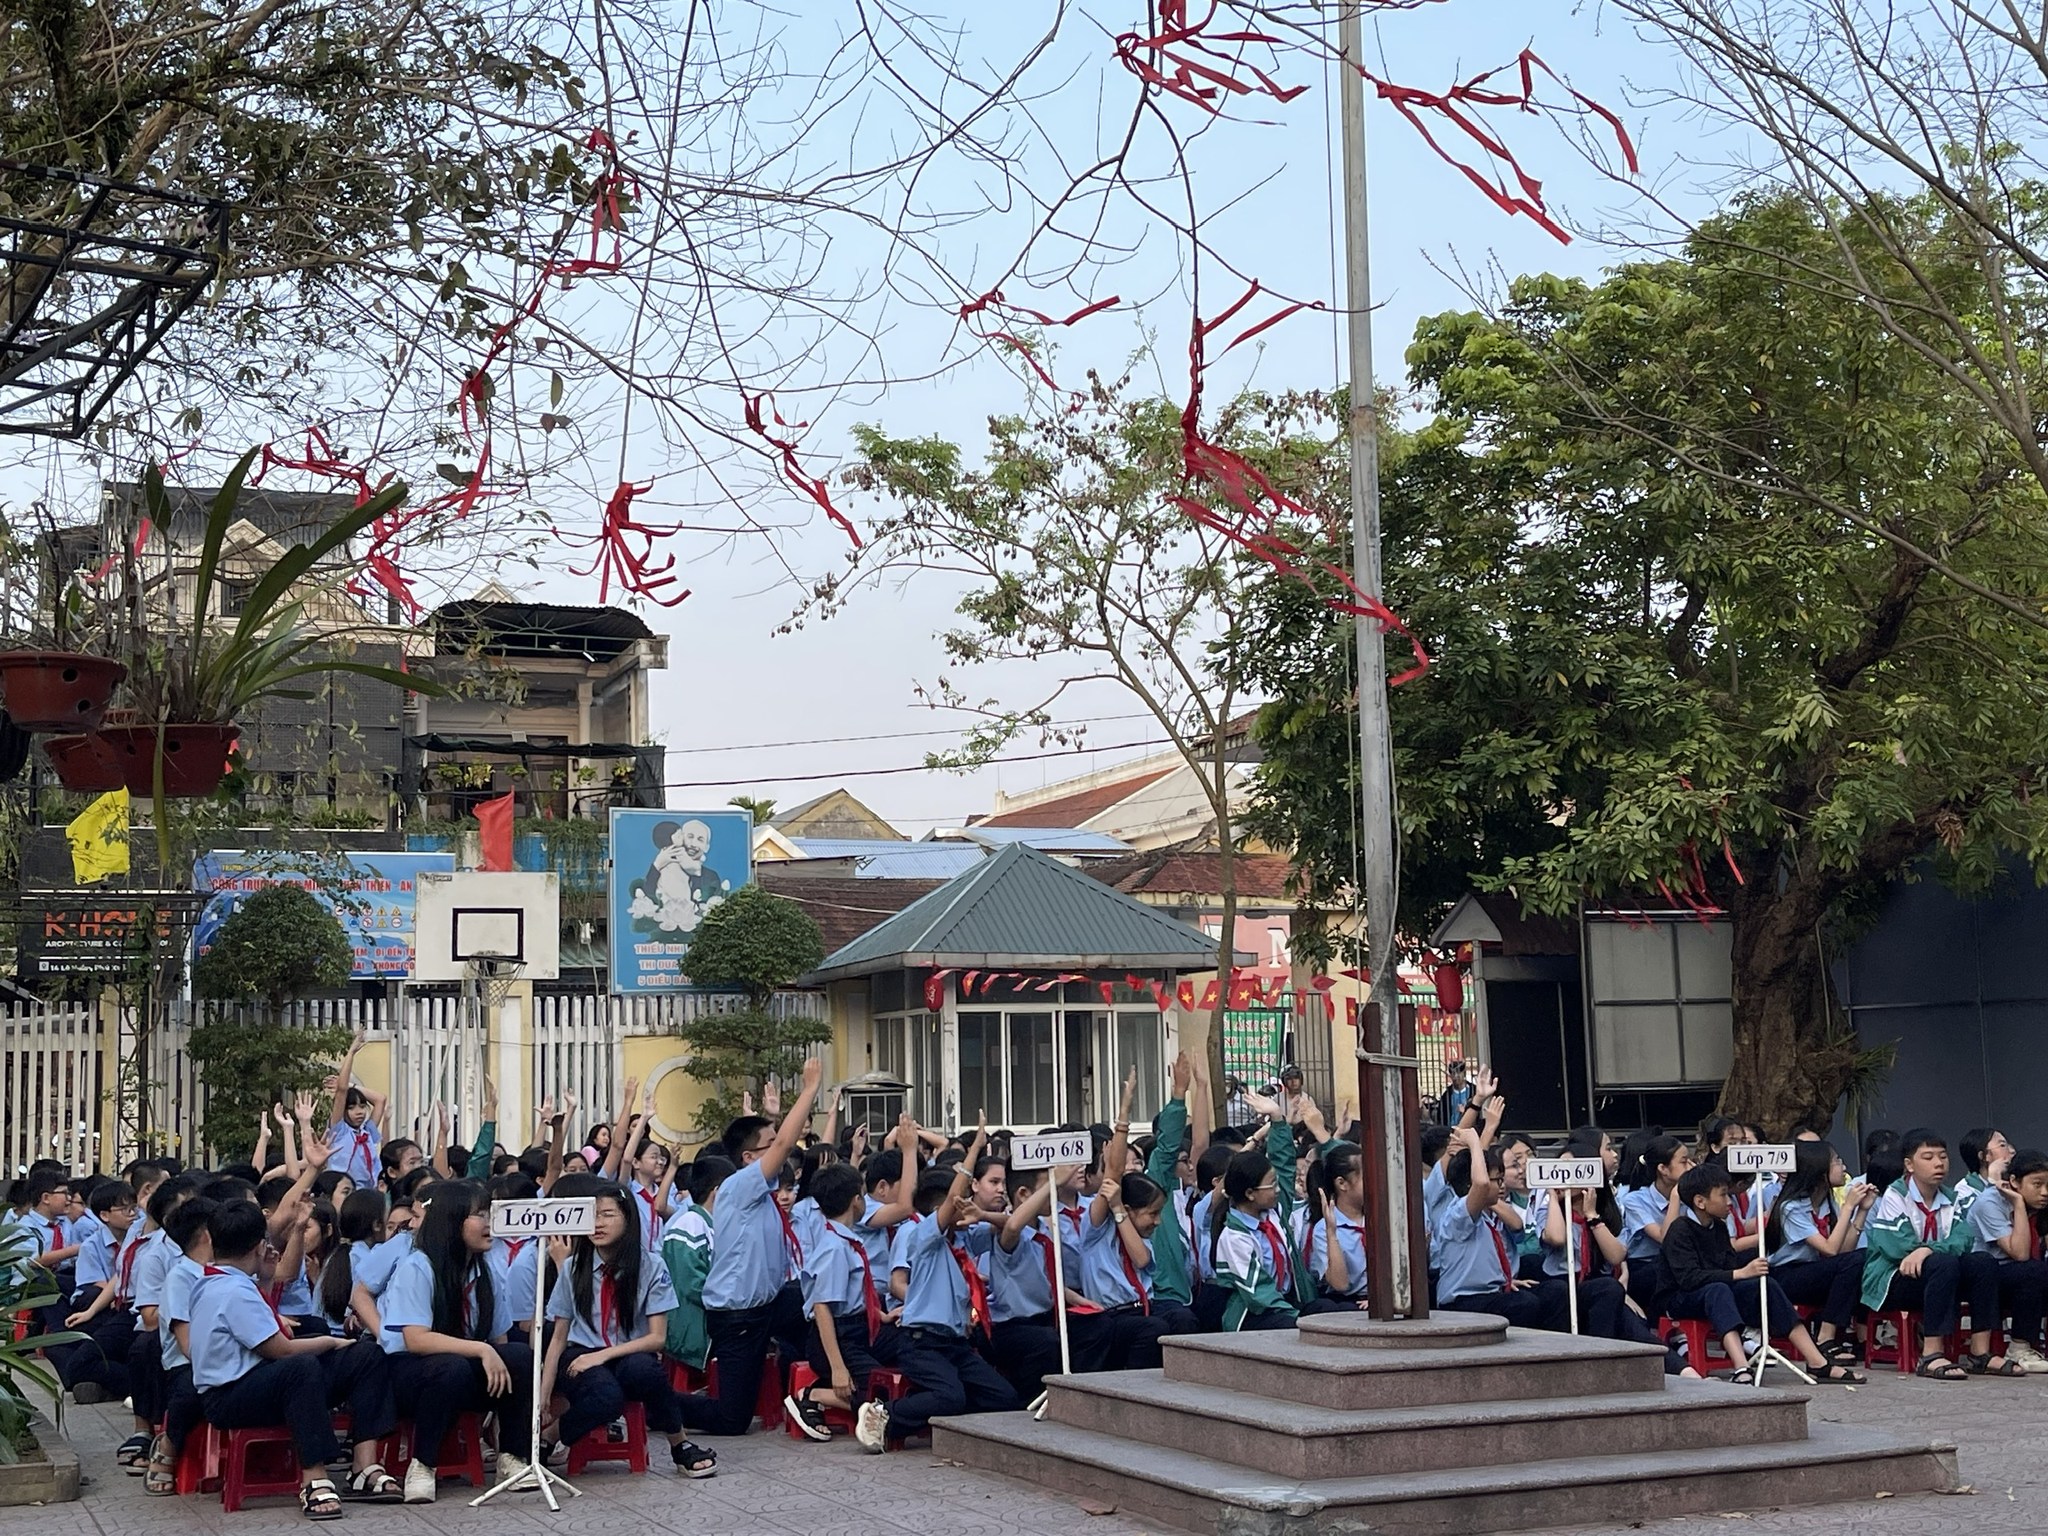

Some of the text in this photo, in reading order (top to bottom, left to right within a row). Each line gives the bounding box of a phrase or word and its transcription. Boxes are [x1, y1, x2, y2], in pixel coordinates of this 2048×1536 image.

[400, 879, 413, 891] AN
[634, 941, 664, 954] THIẾU
[666, 943, 684, 954] NHI
[639, 959, 656, 970] THI
[1021, 1140, 1084, 1162] Lớp 6/8
[1736, 1151, 1788, 1168] Lớp 7/9
[1538, 1163, 1594, 1183] Lớp 6/9
[505, 1207, 584, 1230] Lớp 6/7
